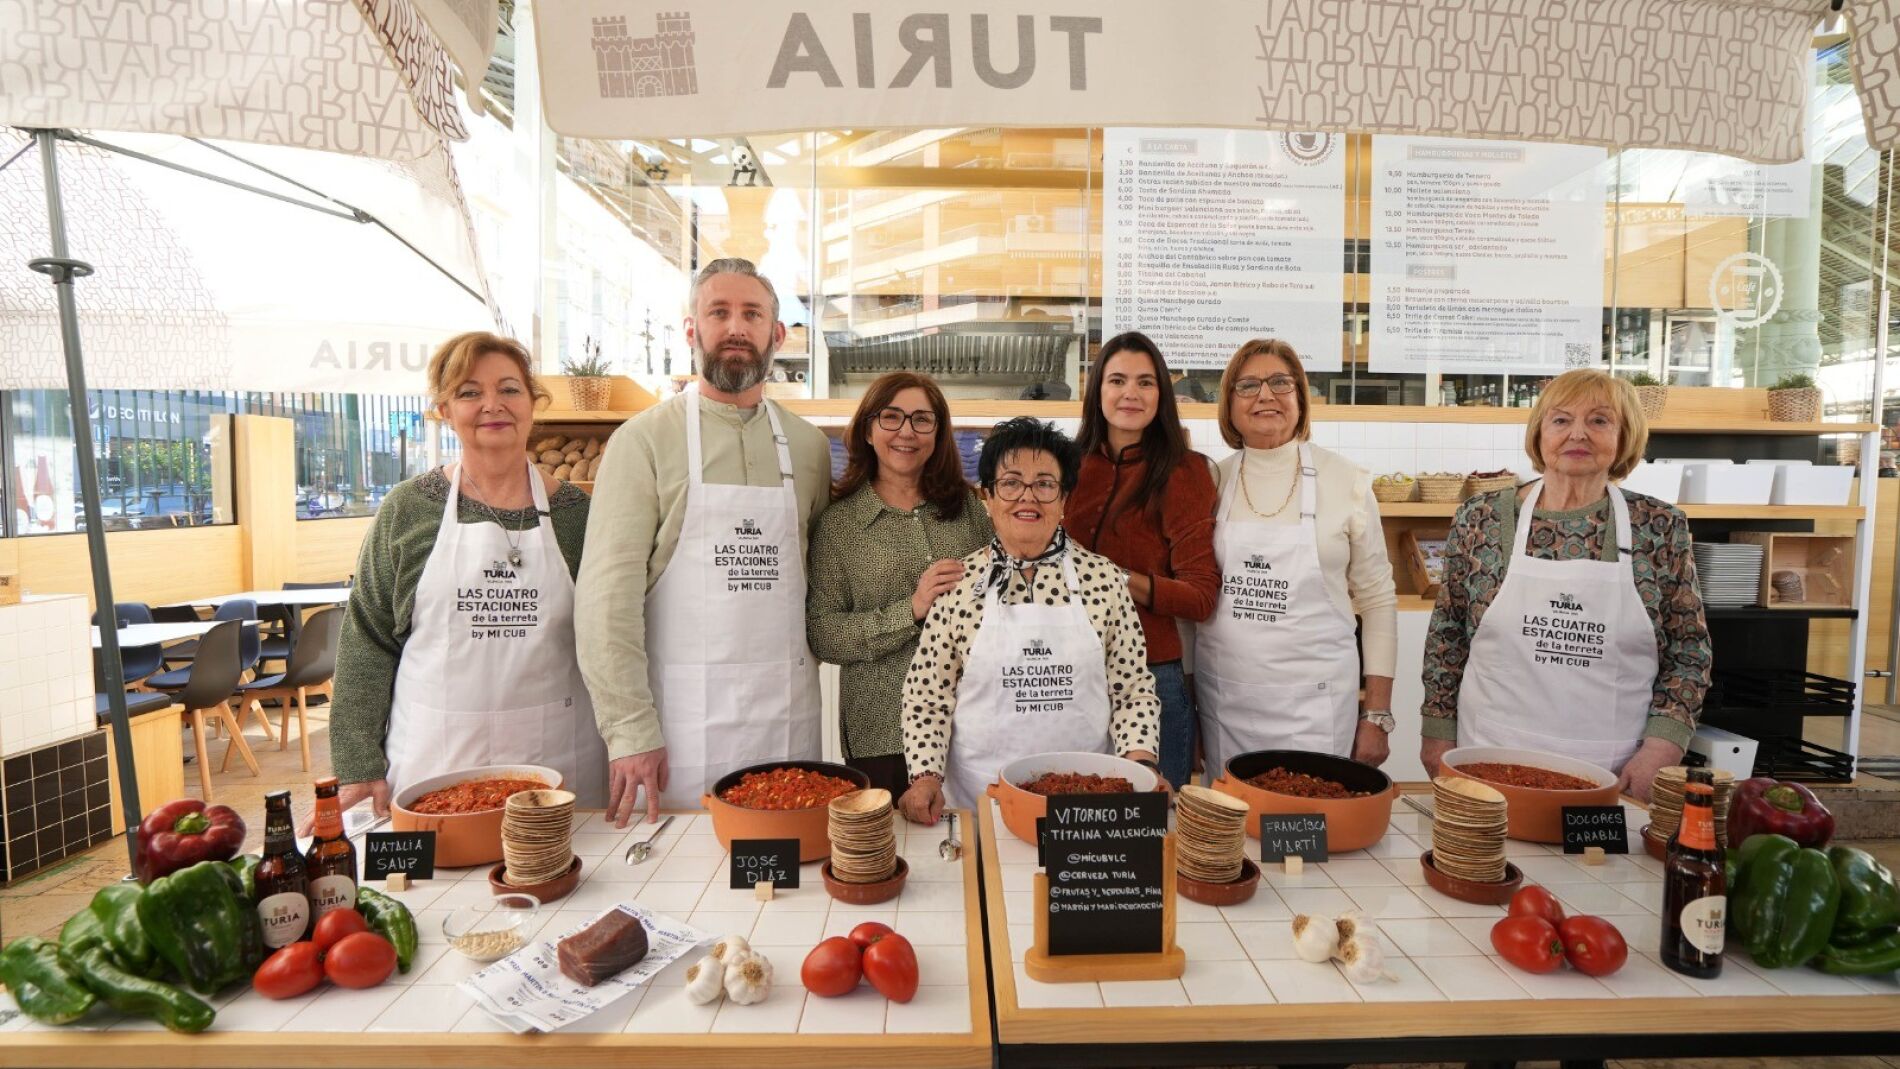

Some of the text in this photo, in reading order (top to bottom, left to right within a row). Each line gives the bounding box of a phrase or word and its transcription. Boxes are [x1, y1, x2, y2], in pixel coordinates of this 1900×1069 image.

[735, 527, 762, 535] TURIA
[714, 544, 779, 555] LAS CUATRO
[715, 556, 779, 566] ESTACIONES
[1244, 561, 1271, 570] TURIA
[484, 569, 516, 578] TURIA
[728, 568, 779, 576] de la terreta
[728, 582, 739, 592] by
[754, 582, 772, 590] CUB
[1223, 575, 1289, 590] LAS CUATRO
[457, 588, 539, 599] LAS CUATRO
[1223, 585, 1288, 601] ESTACIONES
[457, 601, 538, 612] ESTACIONES
[1233, 598, 1287, 610] de la terreta
[1549, 600, 1583, 611] TURIA
[472, 613, 538, 622] de la terreta
[1233, 610, 1276, 622] by MI CUB
[1523, 615, 1606, 633] LAS CUATRO
[472, 629, 526, 639] by MI CUB
[1522, 626, 1604, 645] ESTACIONES
[1022, 648, 1052, 656] TURIA
[1536, 639, 1603, 655] de la terreta
[1535, 654, 1590, 667] by MI CUB
[1002, 664, 1073, 676] LAS CUATRO
[1002, 677, 1073, 688] ESTACIONES
[1015, 688, 1073, 698] de la terreta
[1015, 702, 1064, 714] by MI CUB
[1055, 807, 1141, 825] VI TORNEO DE
[1566, 812, 1623, 825] DOLORES
[1051, 827, 1101, 841] TITAINA
[1106, 826, 1167, 839] VALENCIANA
[370, 839, 422, 853] NATALIA
[736, 854, 778, 868] JOSE
[1059, 870, 1137, 882] @CERVEZA TURIA
[264, 912, 300, 926] TURIA
